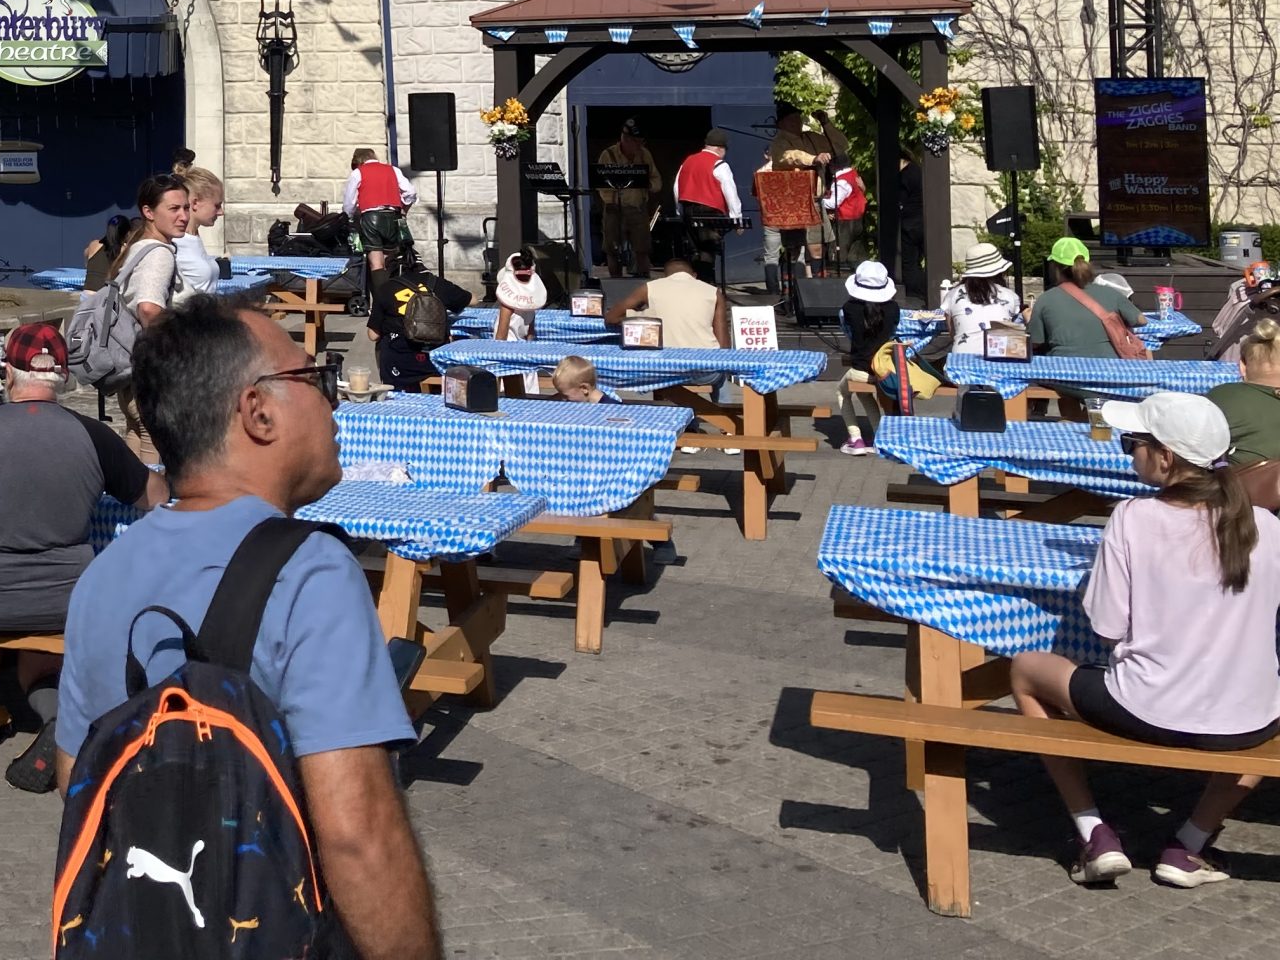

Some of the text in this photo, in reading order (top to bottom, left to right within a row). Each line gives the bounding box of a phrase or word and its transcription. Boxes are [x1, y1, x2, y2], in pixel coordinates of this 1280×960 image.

[1127, 101, 1173, 118] ZIGGIE
[1126, 112, 1185, 130] ZAGGIES
[1124, 173, 1169, 186] Happy
[1124, 185, 1200, 195] Wanderer's
[513, 294, 535, 305] APPLE
[739, 317, 769, 326] Please
[740, 327, 770, 336] KEEP
[745, 337, 768, 346] OFF
